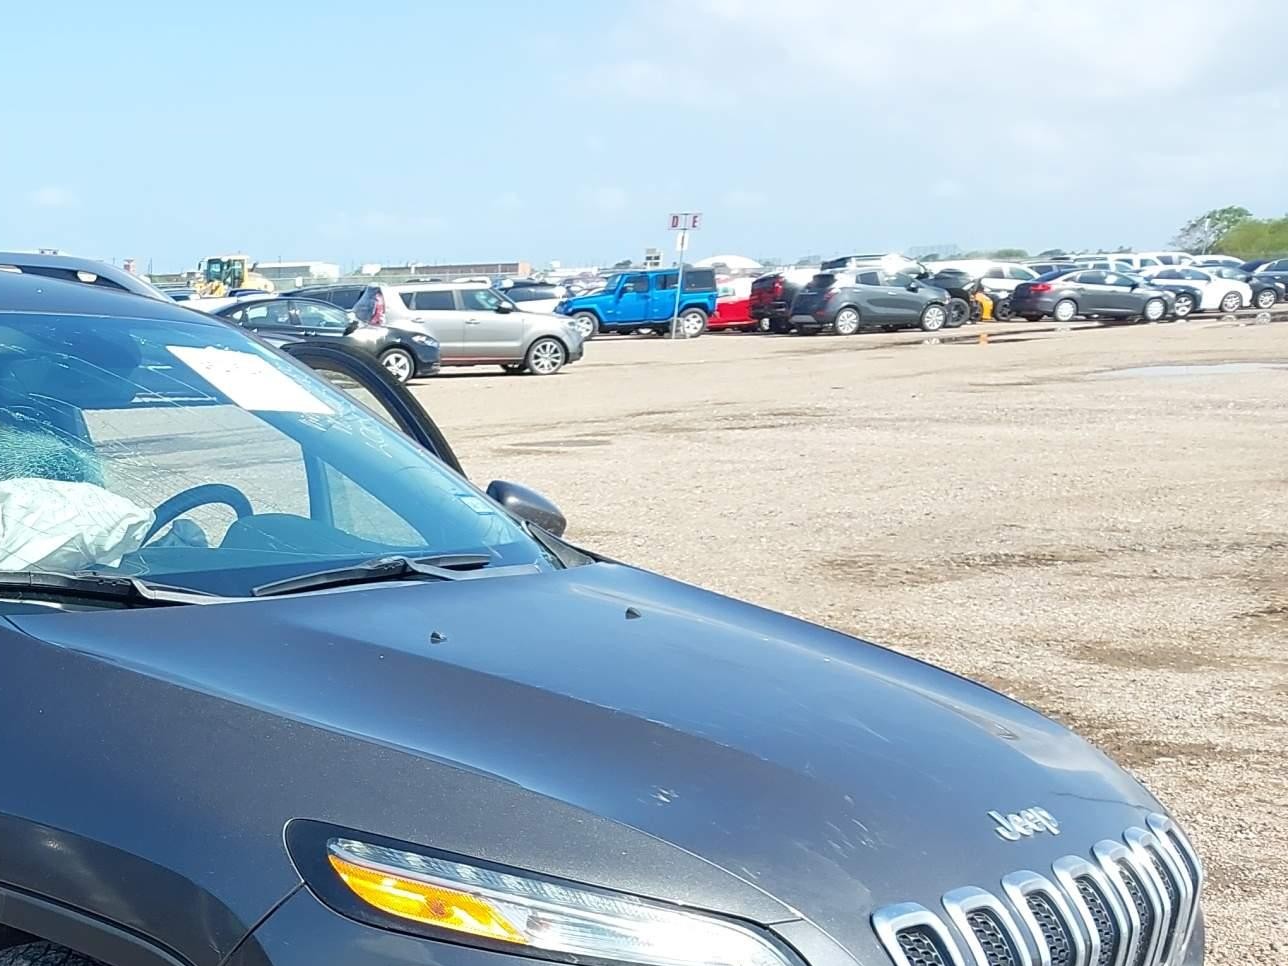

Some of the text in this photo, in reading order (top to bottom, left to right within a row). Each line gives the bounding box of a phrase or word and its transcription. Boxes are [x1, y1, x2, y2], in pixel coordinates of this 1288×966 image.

[672, 216, 679, 227] D
[692, 216, 698, 228] E
[987, 806, 1060, 841] Jeep
